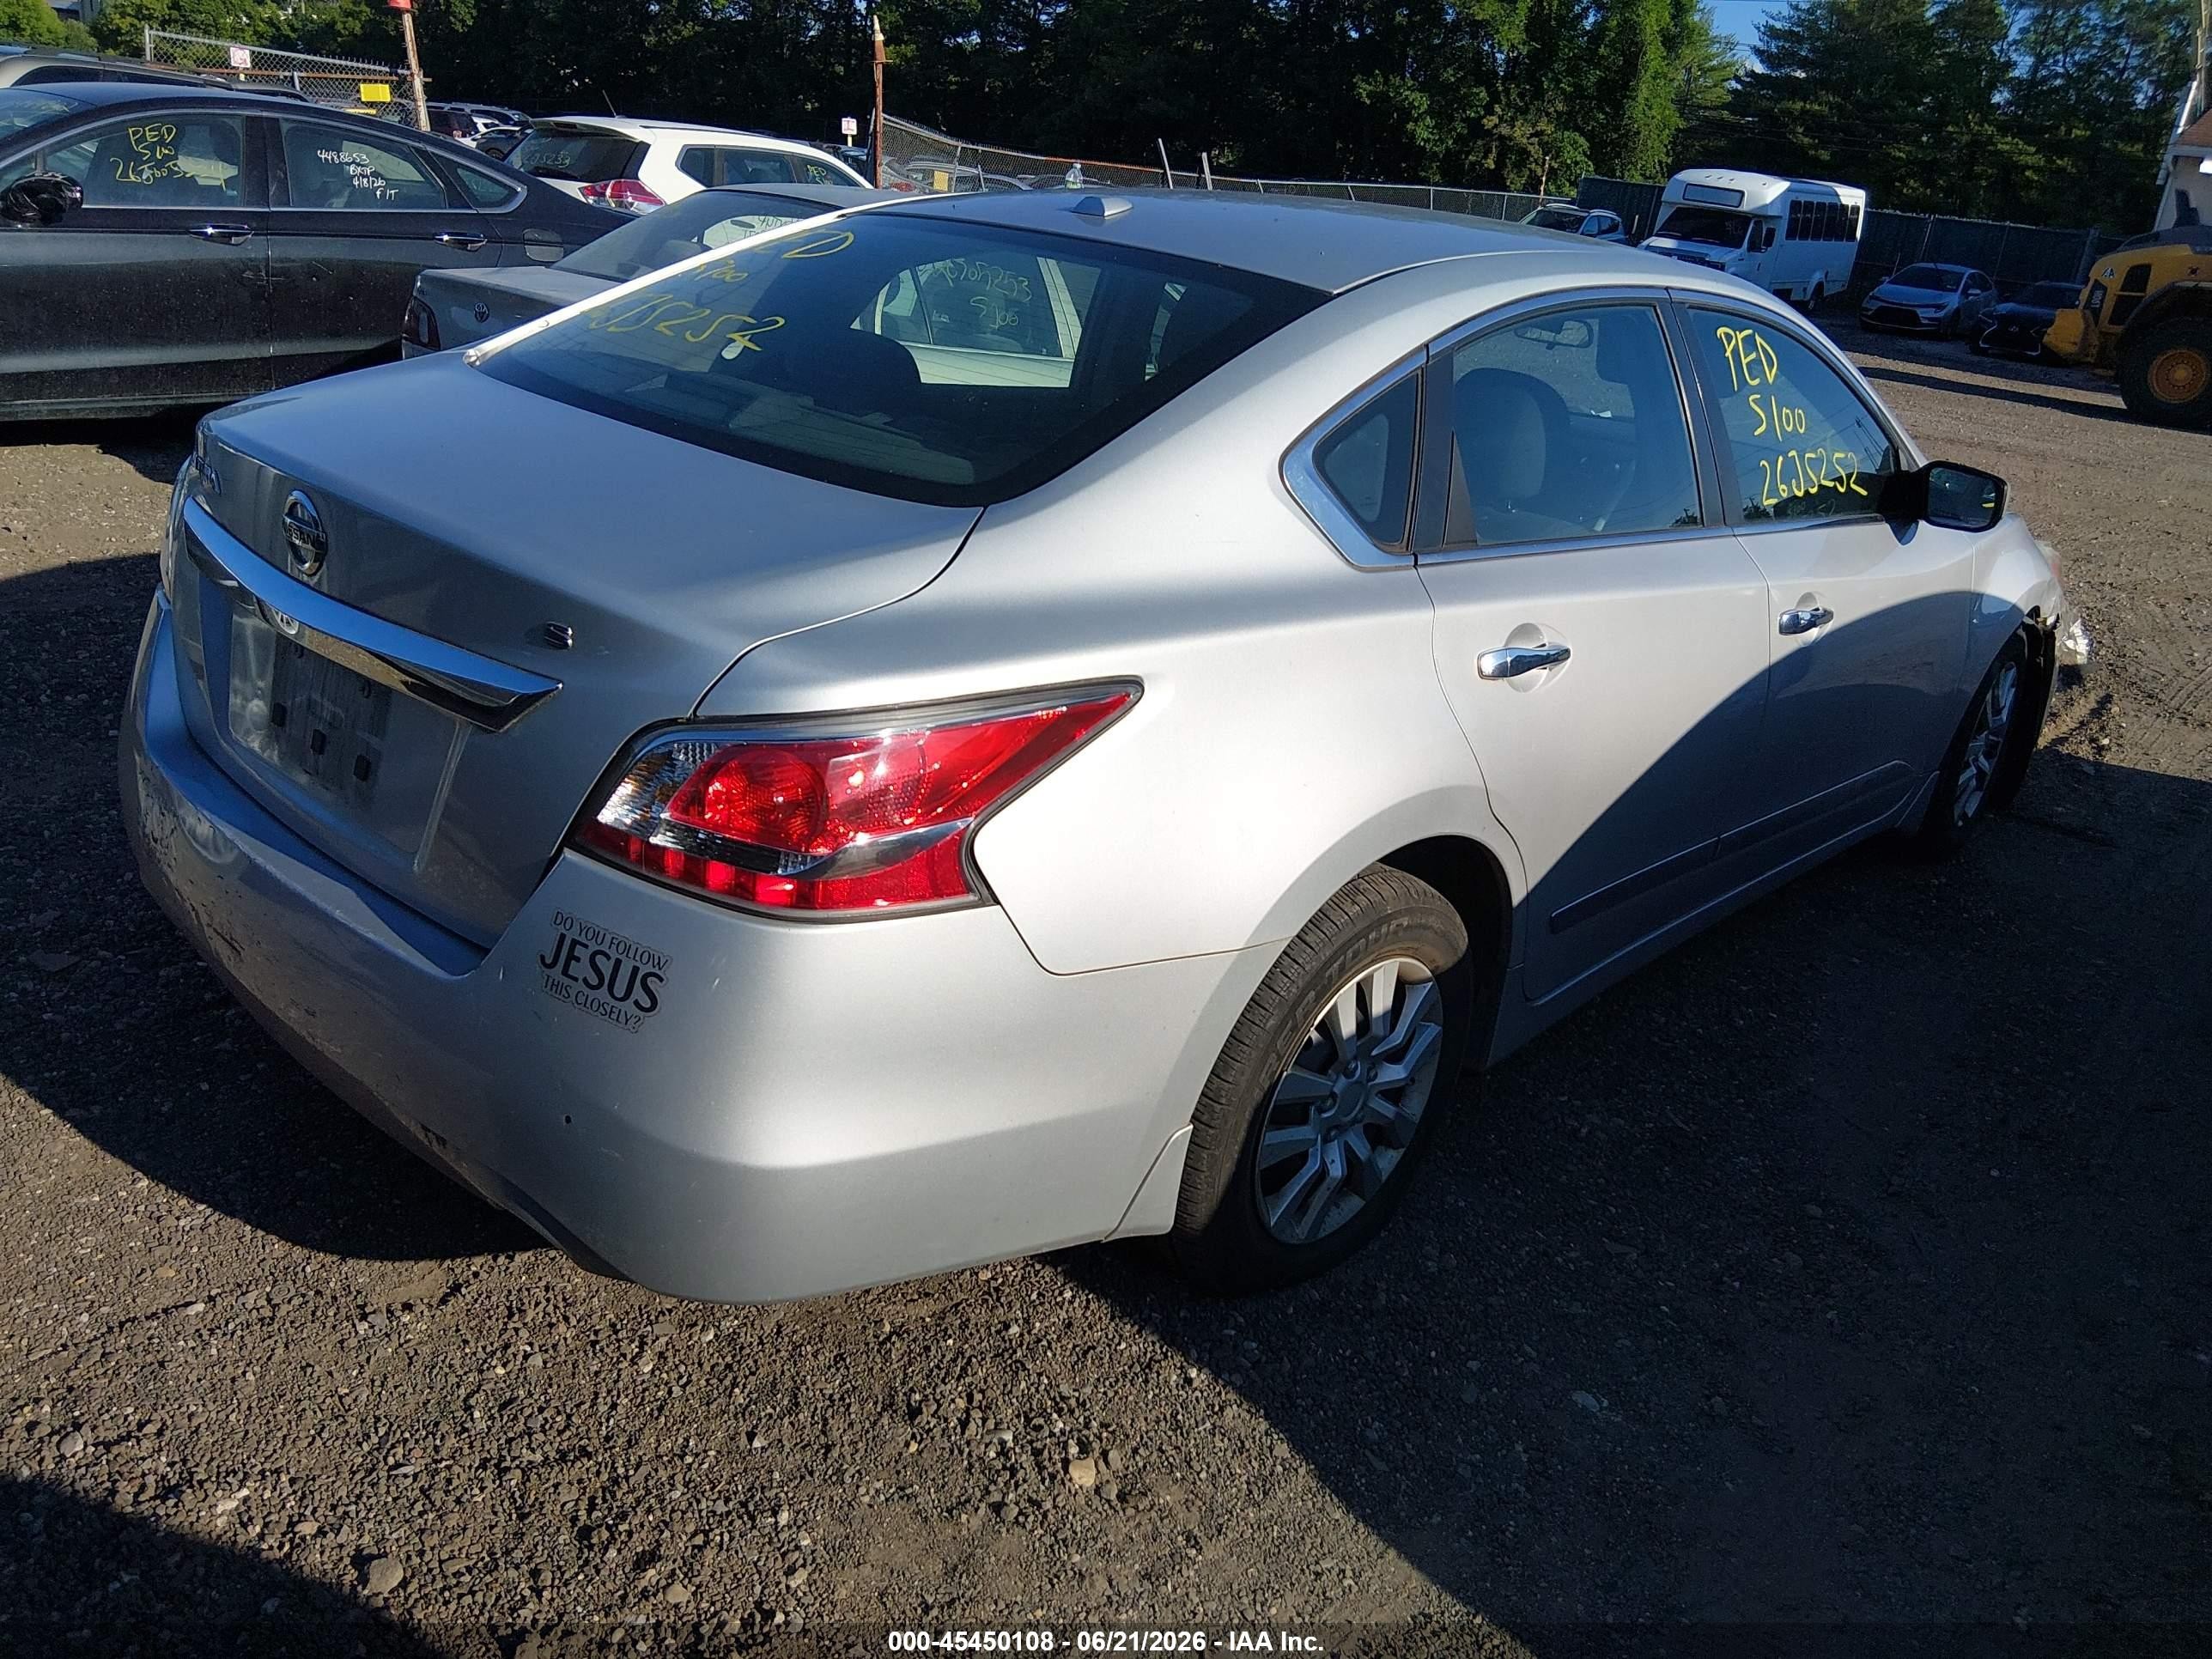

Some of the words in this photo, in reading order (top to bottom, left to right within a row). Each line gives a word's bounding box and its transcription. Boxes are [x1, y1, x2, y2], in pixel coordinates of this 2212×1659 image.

[1717, 326, 1778, 392] PED
[539, 932, 665, 1013] JESUS
[553, 911, 574, 932] DO
[578, 921, 606, 946] YOU
[608, 937, 669, 971] FOLLOW
[544, 974, 573, 1000] THIS
[574, 990, 641, 1030] CLOSELY?
